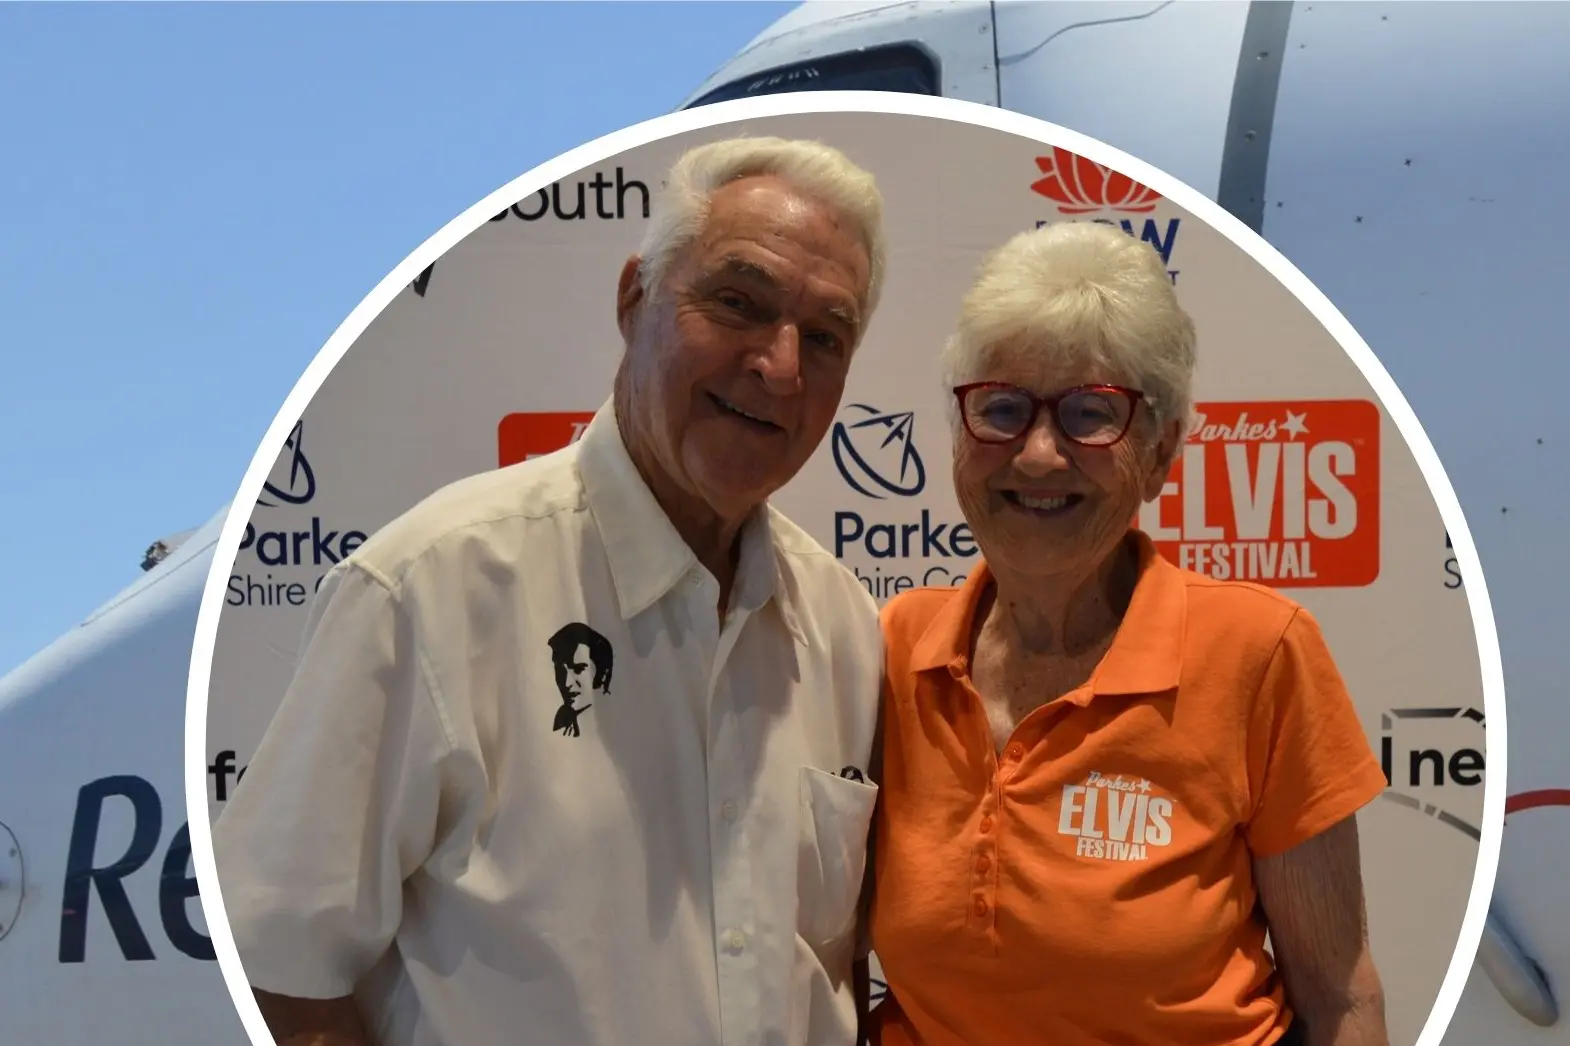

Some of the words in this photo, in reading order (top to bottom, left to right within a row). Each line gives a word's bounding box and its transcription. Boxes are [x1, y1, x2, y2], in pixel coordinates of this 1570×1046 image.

[487, 167, 650, 222] outh
[1138, 440, 1358, 541] ELVIS
[1179, 542, 1316, 580] FESTIVAL
[227, 574, 306, 606] Shire
[1058, 784, 1172, 846] ELVIS
[1076, 836, 1148, 861] FESTIVAL
